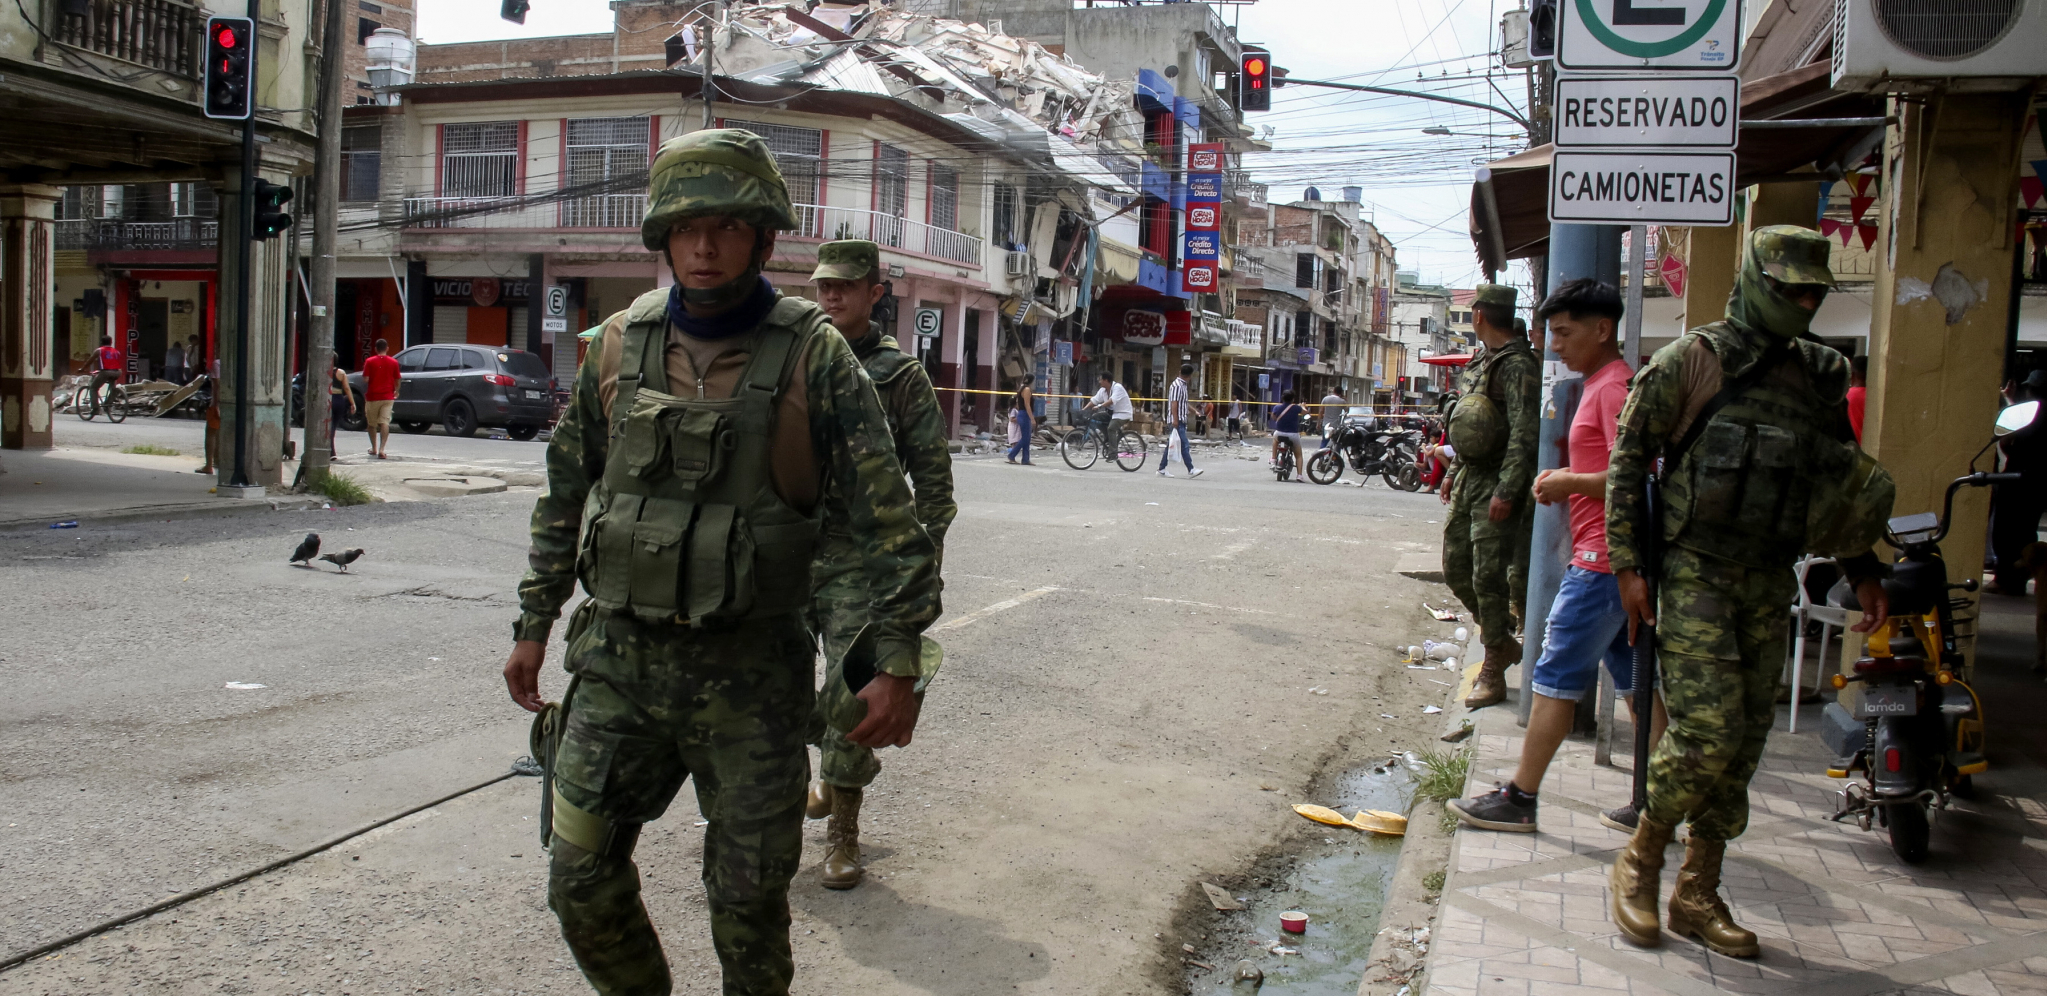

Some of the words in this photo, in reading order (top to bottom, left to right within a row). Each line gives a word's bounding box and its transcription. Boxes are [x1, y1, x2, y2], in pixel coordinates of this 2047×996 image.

[1565, 96, 1727, 128] RESERVADO
[1560, 170, 1724, 204] CAMIONETAS
[1188, 240, 1212, 248] Crédito
[1191, 247, 1215, 255] Directo
[1190, 275, 1210, 283] HOGAR
[433, 281, 472, 296] VICIO
[552, 294, 562, 309] E
[1379, 290, 1387, 325] HOTEL
[546, 321, 563, 329] MOTOS
[921, 315, 933, 329] E
[1126, 311, 1161, 326] GRAN
[127, 286, 139, 373] TRIPLE
[1123, 324, 1163, 338] HOGAR
[1864, 701, 1905, 713] lamda
